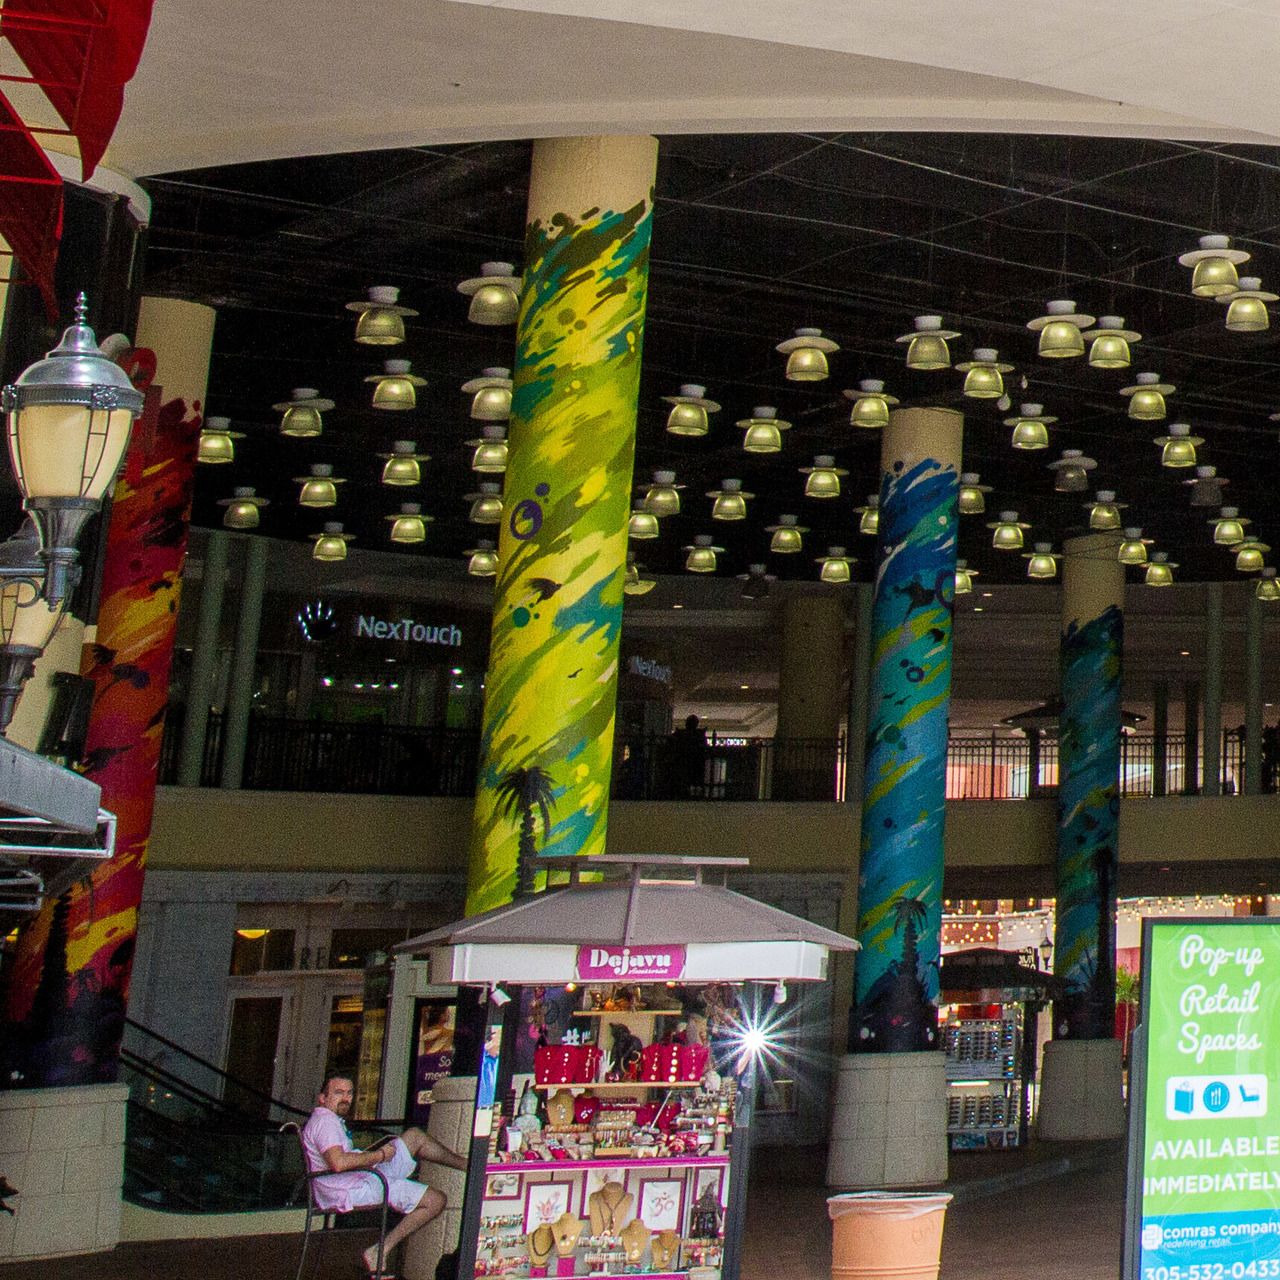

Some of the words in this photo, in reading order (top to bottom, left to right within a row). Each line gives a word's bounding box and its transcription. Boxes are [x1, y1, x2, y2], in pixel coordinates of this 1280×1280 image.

[356, 615, 462, 647] NexTouch
[590, 949, 671, 975] Dejavu
[1179, 934, 1264, 977] Pop-up
[1179, 981, 1262, 1017] Retail
[1177, 1021, 1262, 1064] Spaces
[1151, 1136, 1280, 1161] AVAILABLE
[1162, 1238, 1207, 1249] redefining
[1163, 1224, 1216, 1239] comras
[1145, 1259, 1280, 1280] 305-532-0433
